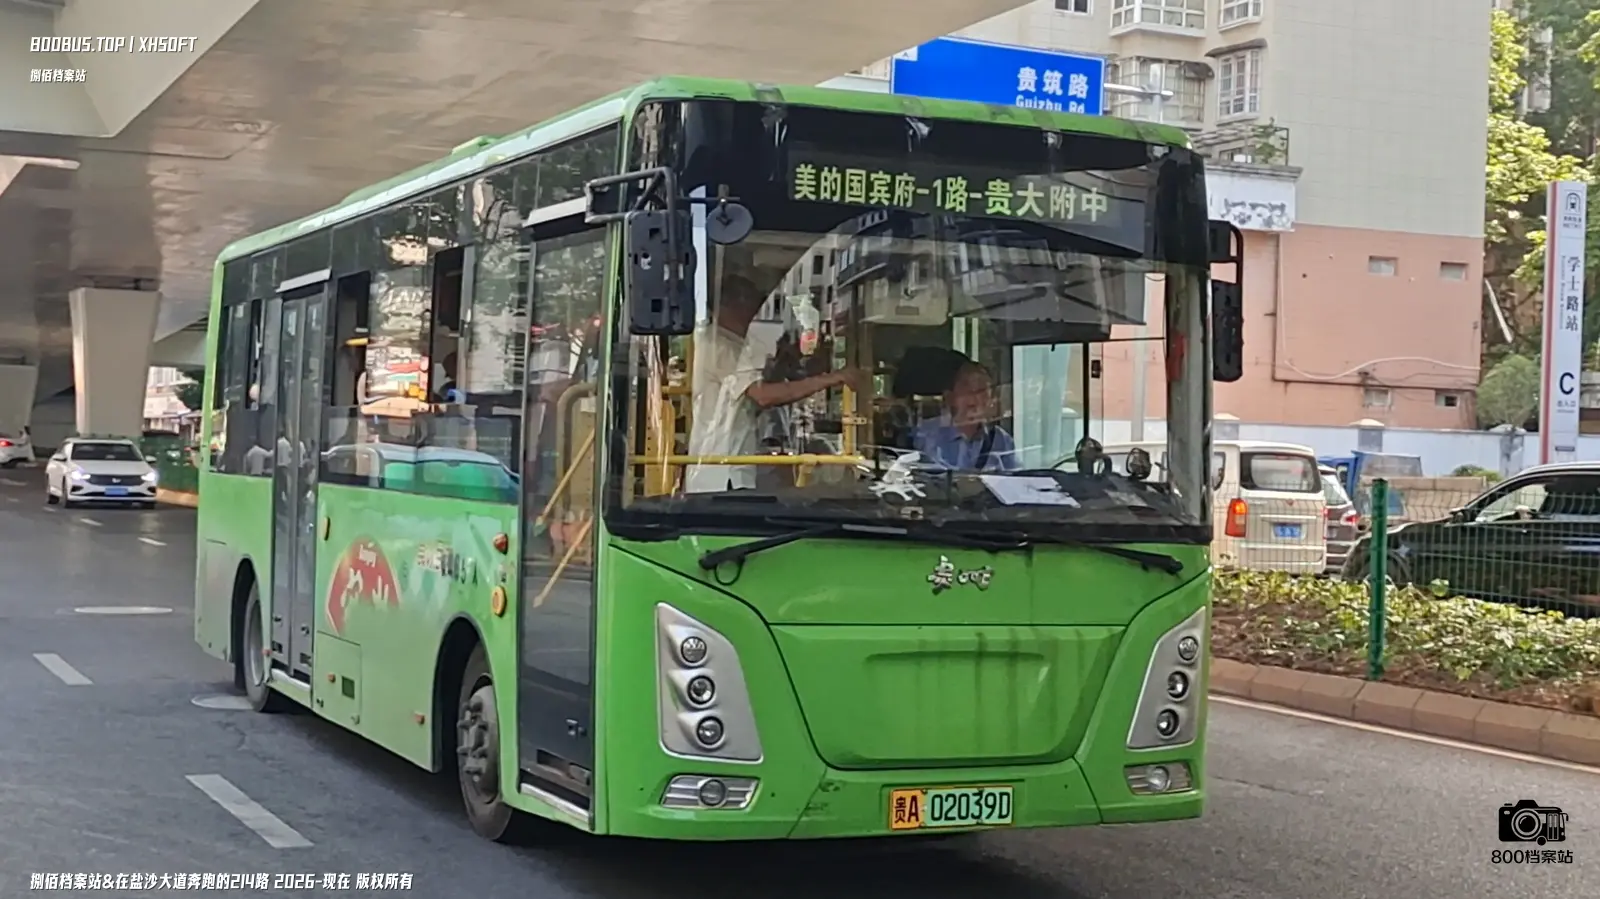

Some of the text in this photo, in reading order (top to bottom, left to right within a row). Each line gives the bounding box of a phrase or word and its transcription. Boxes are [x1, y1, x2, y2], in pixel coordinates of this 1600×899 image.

[1017, 66, 1089, 98] 贵筑路
[794, 164, 1108, 222] 美的国宾府-1路-贵大附中
[1565, 256, 1581, 332] 学士路站
[1559, 372, 1575, 395] C
[894, 792, 1011, 823] 贵A 02039D
